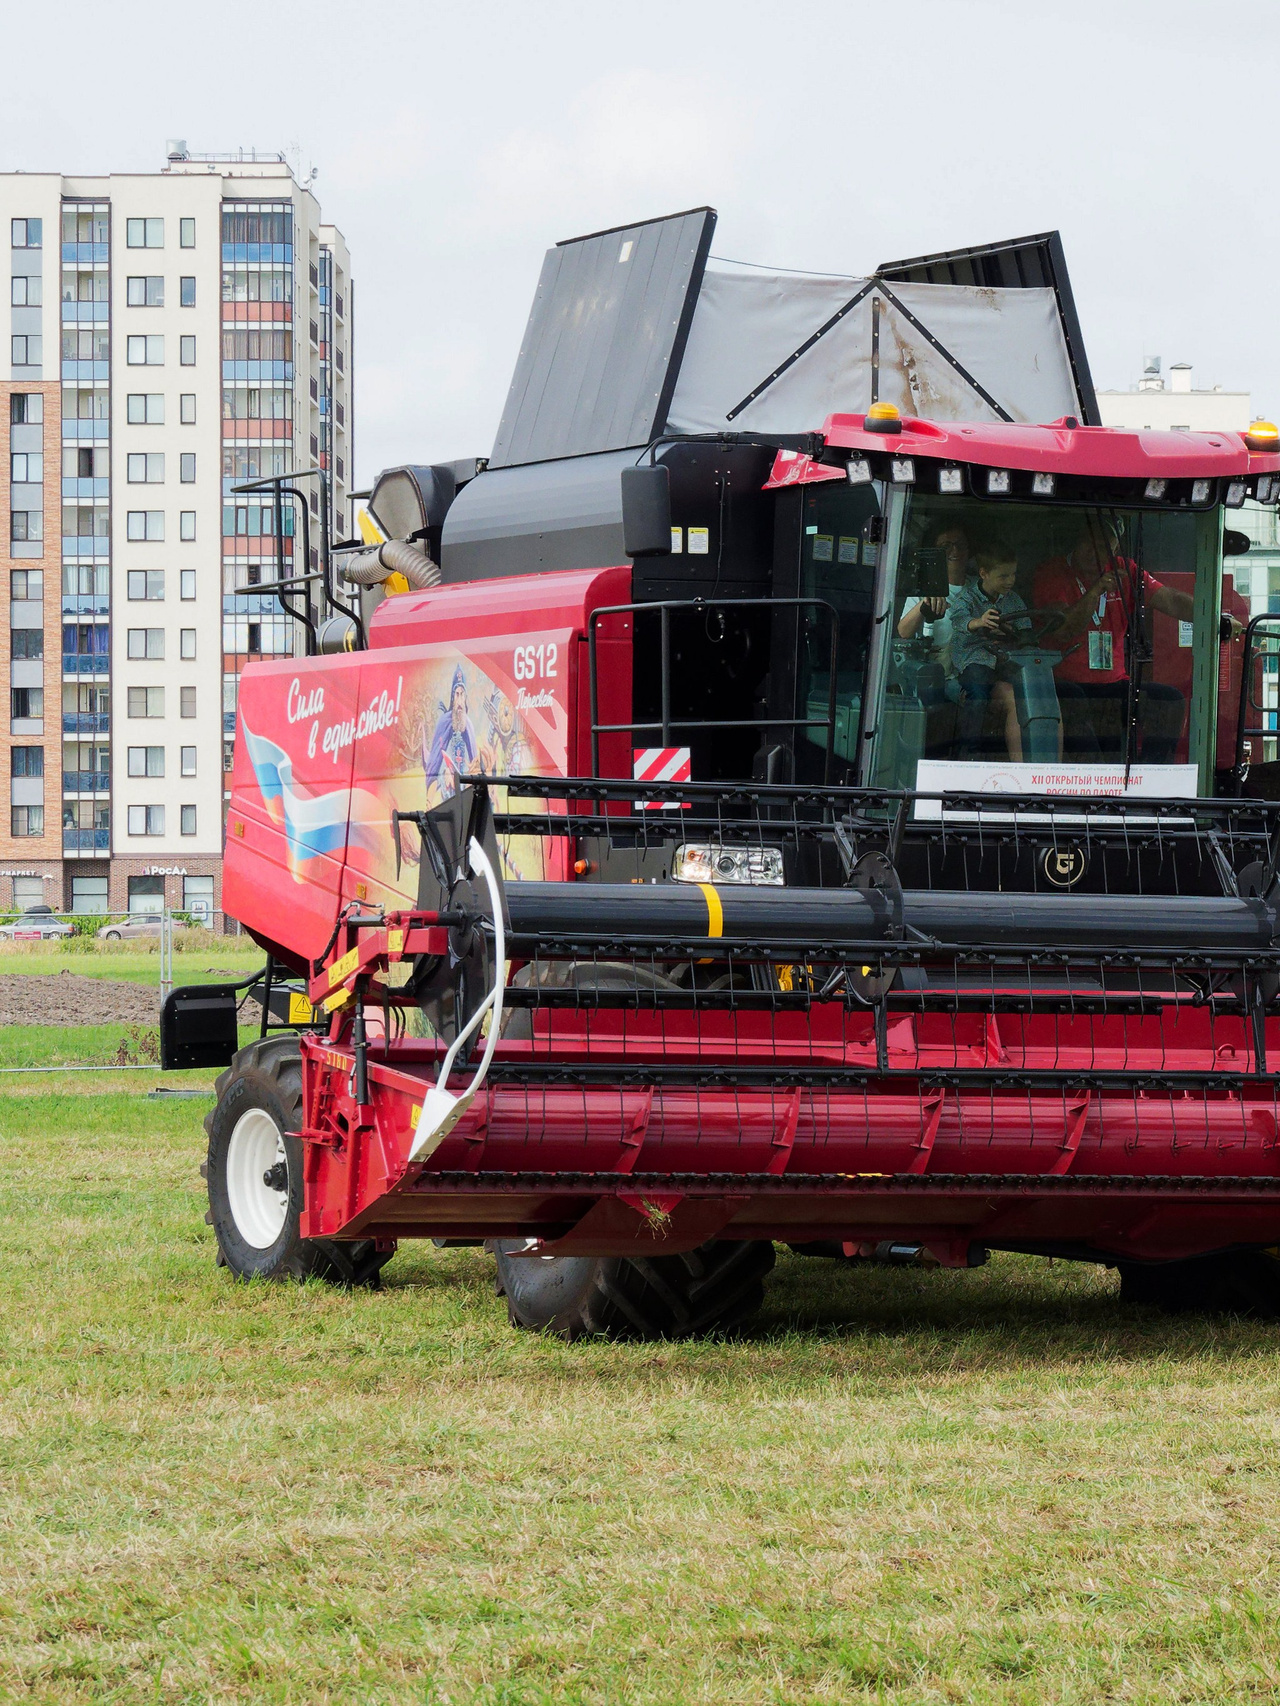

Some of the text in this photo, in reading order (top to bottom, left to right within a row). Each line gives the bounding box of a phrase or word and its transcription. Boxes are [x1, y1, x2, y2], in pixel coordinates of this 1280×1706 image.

[514, 643, 557, 680] GS12
[287, 677, 325, 724] Сила
[307, 720, 319, 759] в
[1045, 774, 1092, 785] ОТКРЫТЫЙ
[1094, 775, 1143, 785] ЧЕМПИОНАТ
